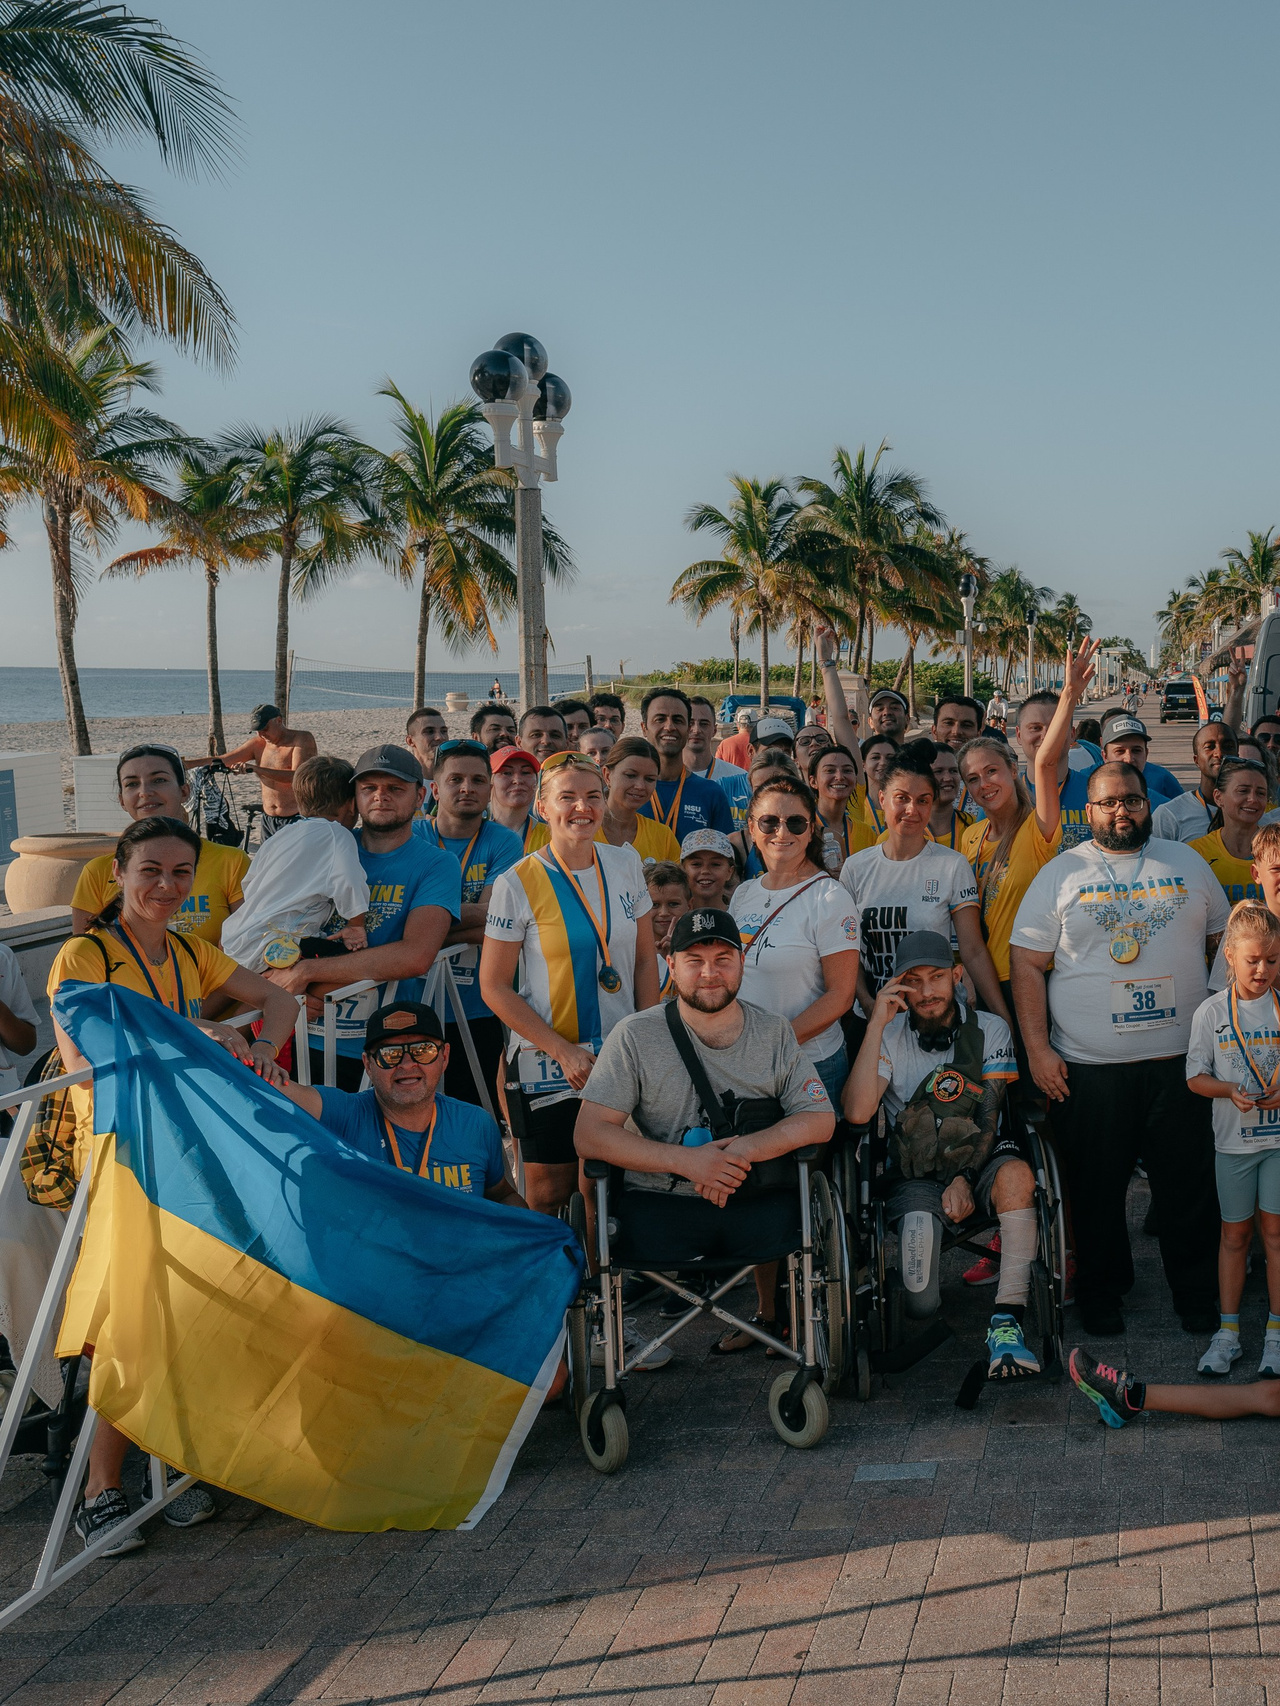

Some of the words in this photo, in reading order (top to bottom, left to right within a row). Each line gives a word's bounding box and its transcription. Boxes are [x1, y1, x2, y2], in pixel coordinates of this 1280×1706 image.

[1115, 721, 1141, 729] PING
[684, 804, 701, 813] NSU
[1079, 877, 1188, 902] UKRAINE
[866, 906, 908, 930] RUN
[1132, 990, 1156, 1011] 38
